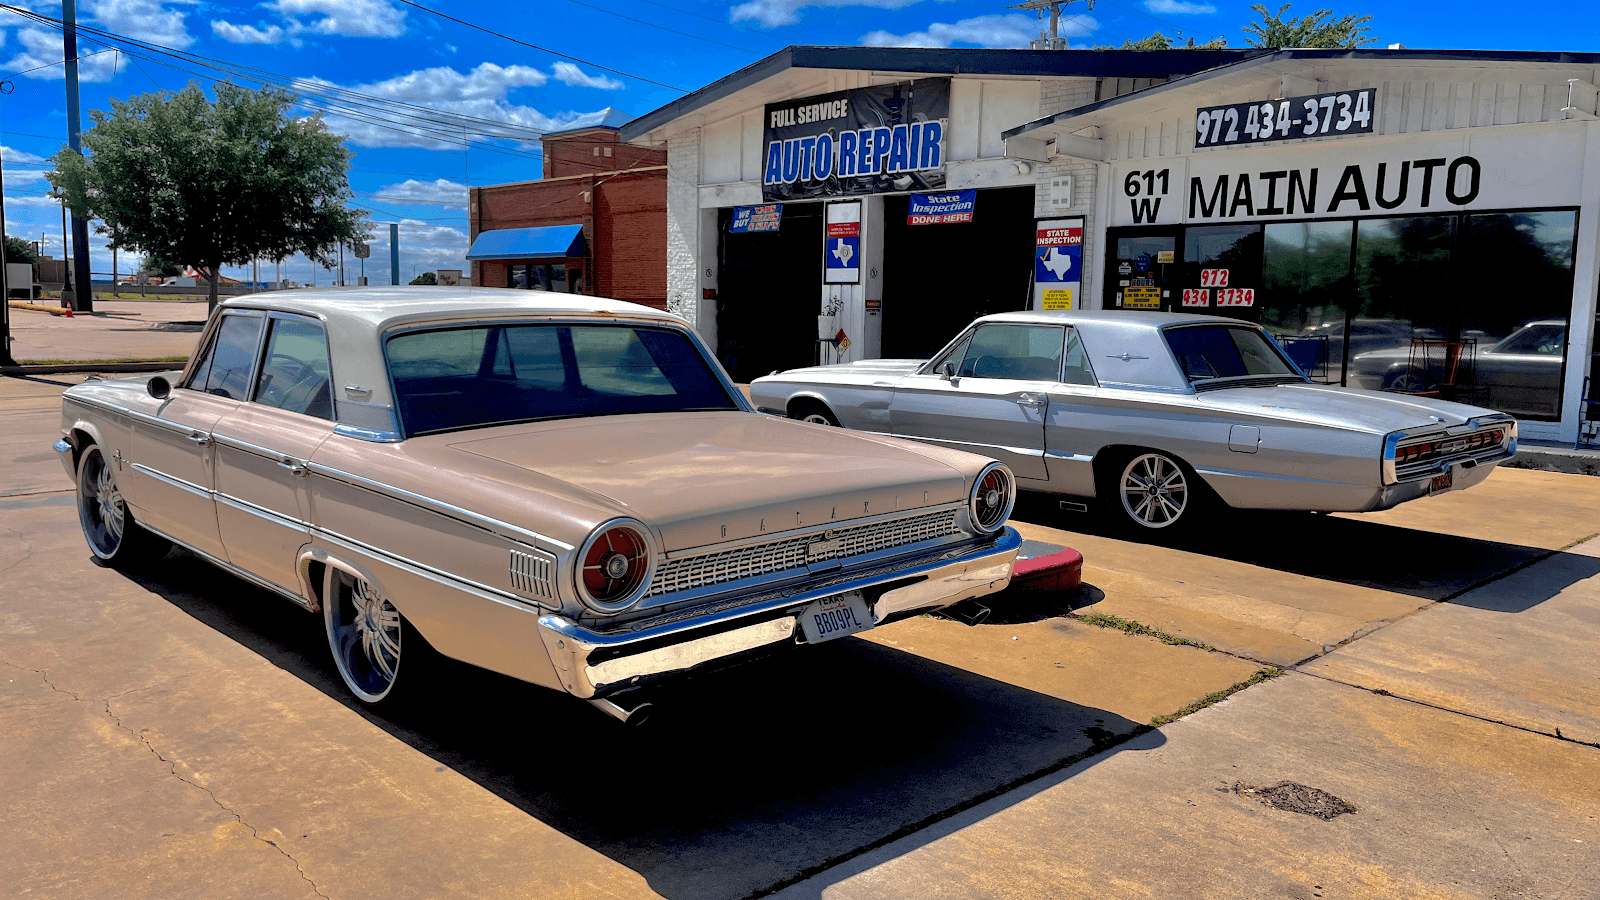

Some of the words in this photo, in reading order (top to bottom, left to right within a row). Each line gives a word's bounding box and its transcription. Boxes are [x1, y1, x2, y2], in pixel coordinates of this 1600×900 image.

[771, 108, 796, 129] FULL
[798, 99, 848, 125] SERVICE
[1197, 108, 1239, 145] 972
[1244, 91, 1371, 140] 434-3734
[764, 132, 834, 186] AUTO
[837, 120, 943, 179] REPAIR
[1124, 168, 1170, 197] 611
[1188, 167, 1319, 219] MAIN
[1327, 155, 1482, 213] AUTO
[912, 201, 972, 214] Inspection
[928, 195, 960, 204] State
[738, 210, 751, 219] WE
[912, 216, 941, 224] DONE
[943, 213, 970, 223] HERE
[1130, 197, 1161, 224] W
[733, 218, 750, 229] BUY
[1036, 236, 1081, 245] INSPECTION
[1046, 229, 1070, 238] STATE
[1202, 270, 1228, 286] 972
[1183, 289, 1208, 305] 434
[1217, 288, 1253, 306] 3734
